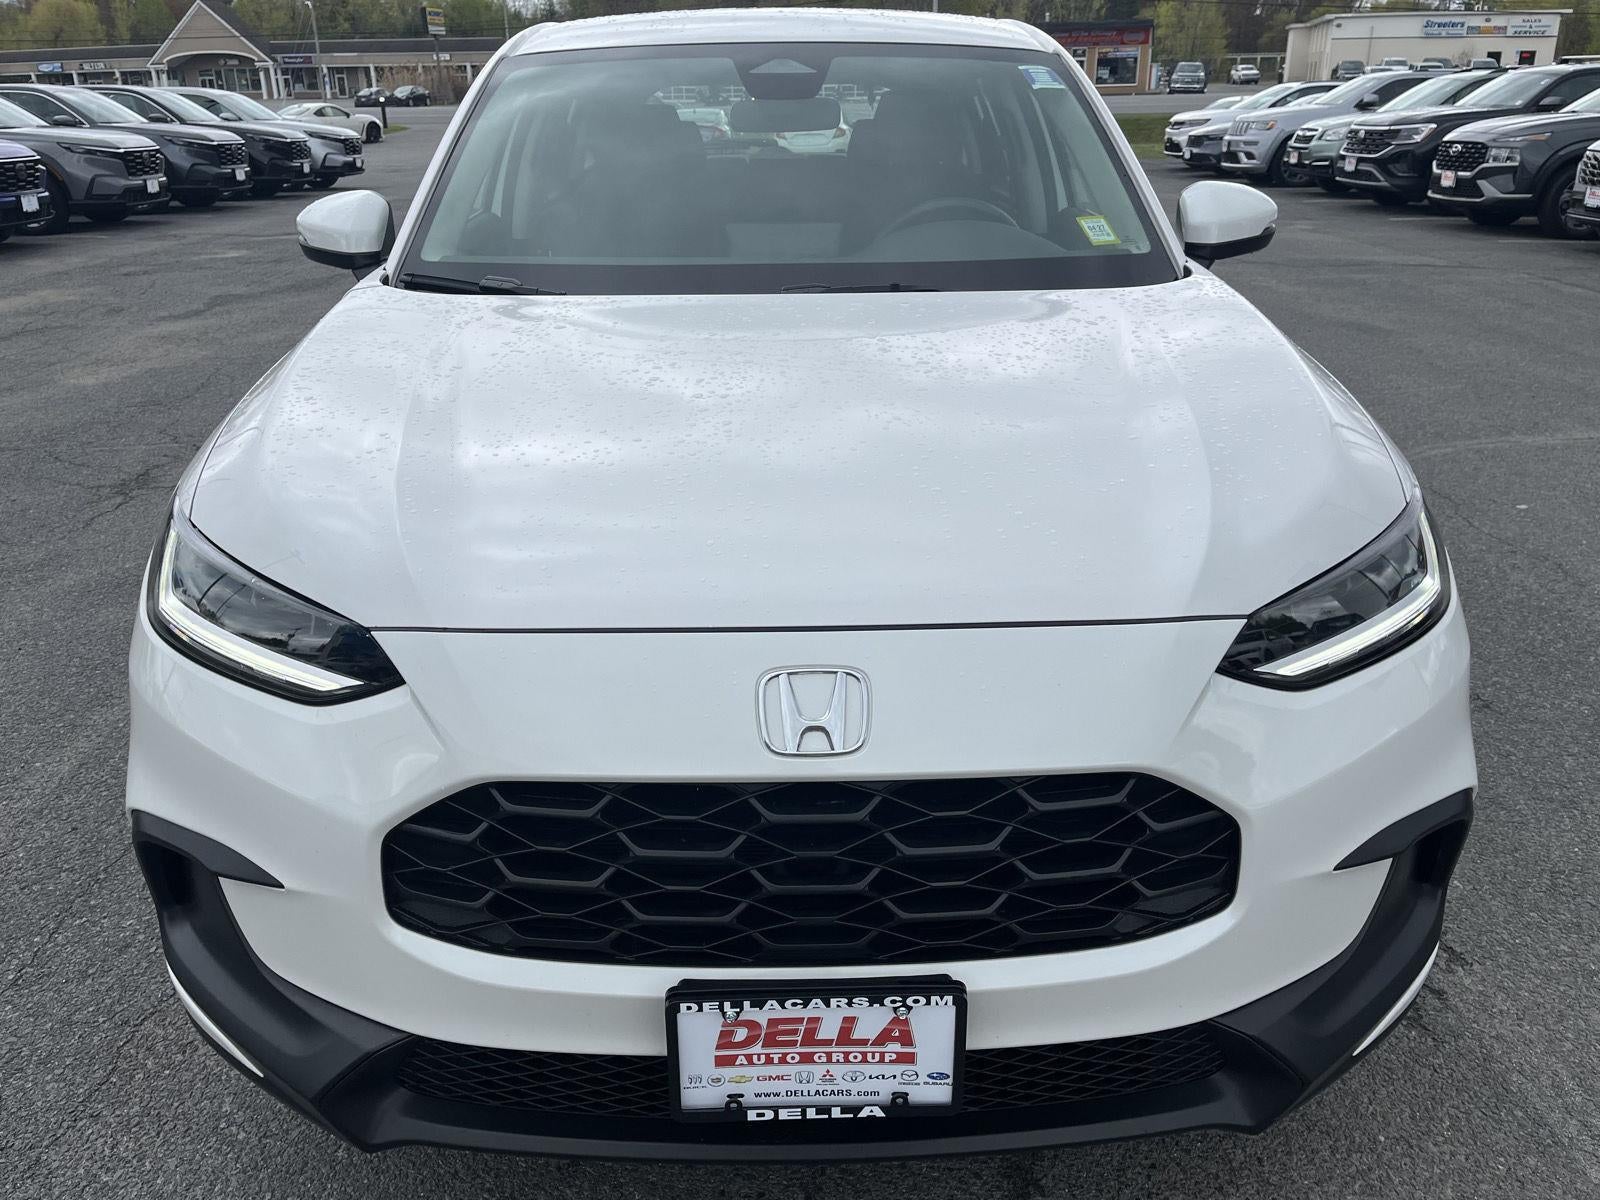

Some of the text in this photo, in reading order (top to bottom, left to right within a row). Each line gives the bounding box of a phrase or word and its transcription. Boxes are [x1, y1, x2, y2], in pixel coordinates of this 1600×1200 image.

[1423, 20, 1466, 29] Streeters
[679, 995, 953, 1014] DELLACARS.COM
[715, 1015, 916, 1052] DELLA
[734, 1051, 897, 1066] AUTO GROUP
[756, 1074, 792, 1082] GMC
[753, 1089, 880, 1098] www.DELLACARS.com
[747, 1105, 886, 1121] DELLA
